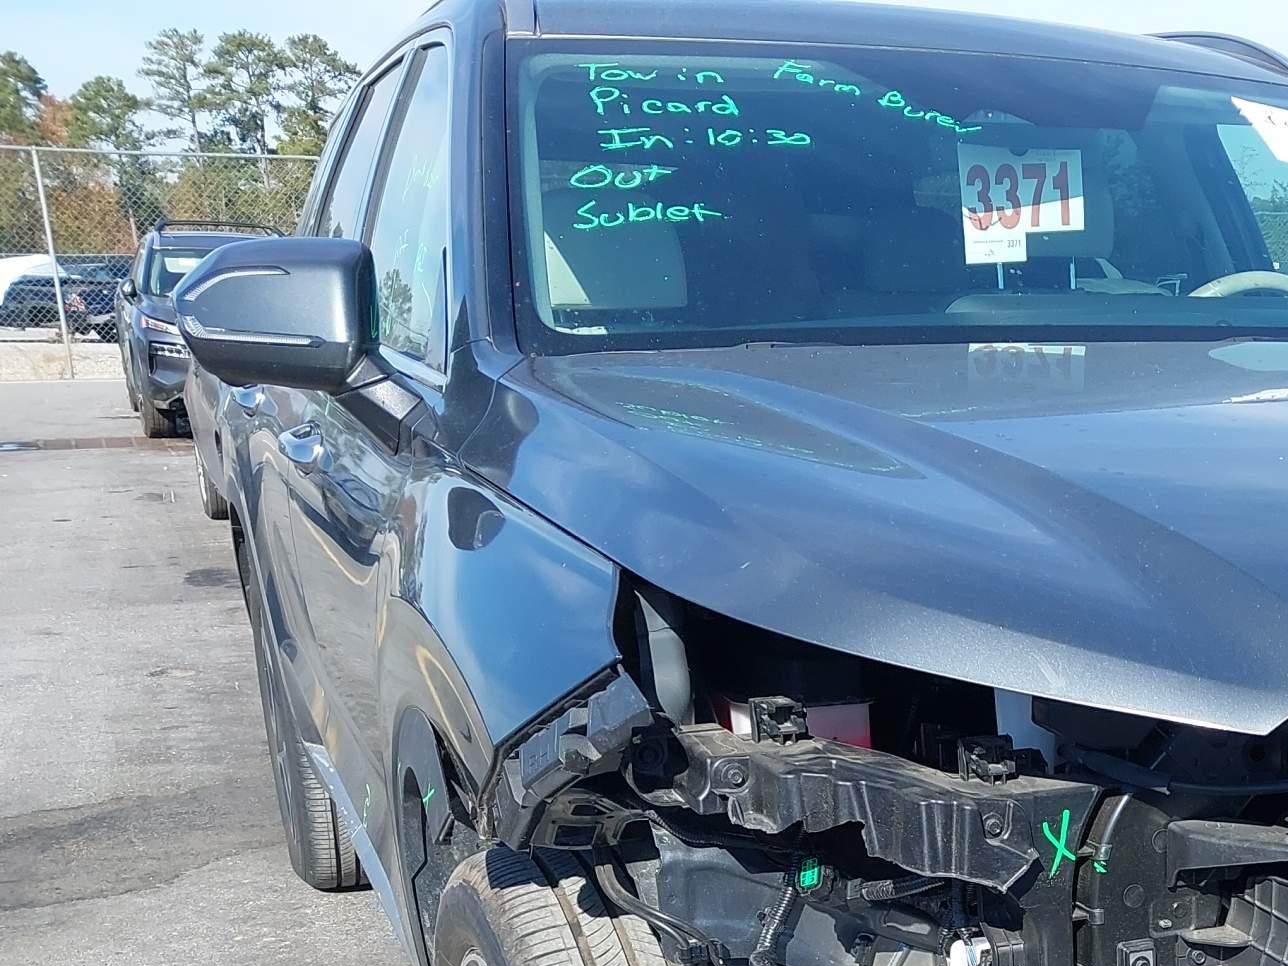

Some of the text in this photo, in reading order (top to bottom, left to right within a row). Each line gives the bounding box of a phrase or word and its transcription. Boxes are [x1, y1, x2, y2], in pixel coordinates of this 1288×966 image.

[577, 62, 657, 82] Tow
[678, 66, 724, 84] in
[773, 59, 861, 96] Farm
[590, 86, 739, 117] Picard
[570, 164, 674, 189] Out
[966, 160, 1071, 231] 3371
[574, 200, 723, 231] Sublet
[1006, 239, 1021, 248] 3371
